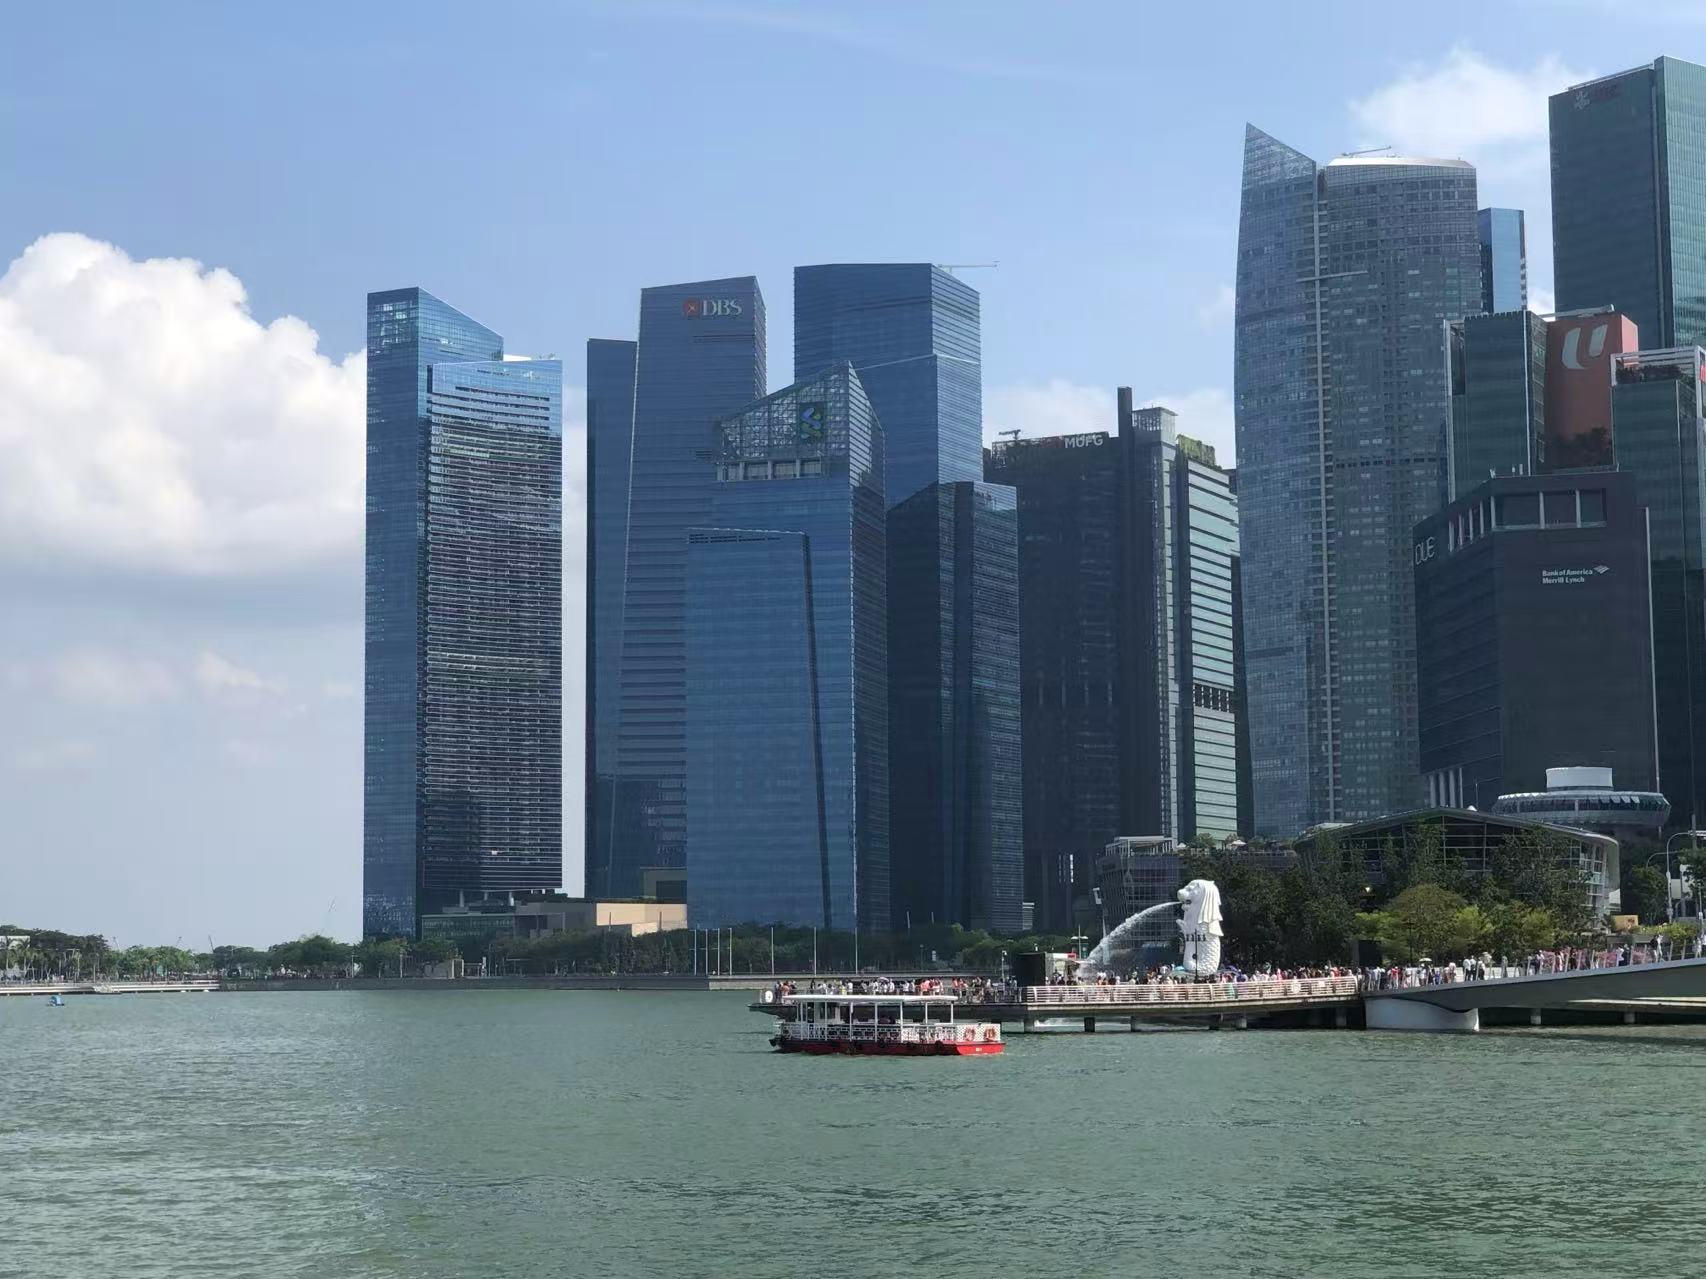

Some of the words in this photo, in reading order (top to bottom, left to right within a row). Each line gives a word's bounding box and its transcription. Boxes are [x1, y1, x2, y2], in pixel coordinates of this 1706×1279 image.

[702, 299, 742, 316] DBS
[1065, 434, 1104, 449] MUFG
[1542, 569, 1558, 577] Bank
[1566, 568, 1593, 576] America
[1565, 576, 1585, 584] Lynch
